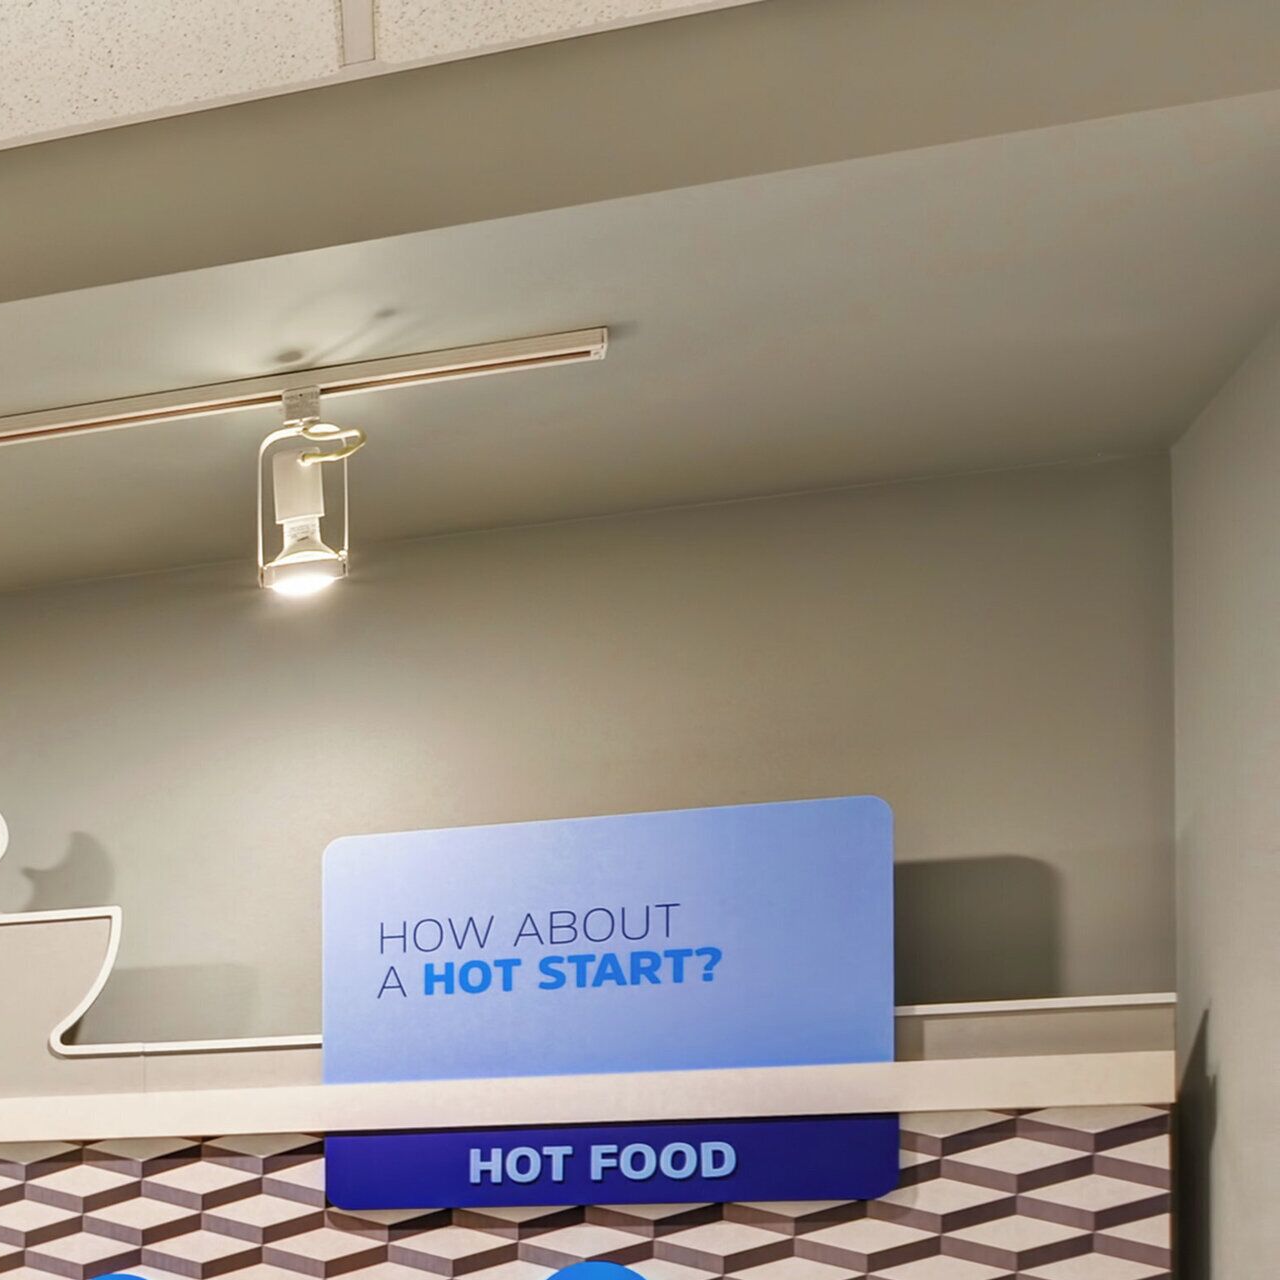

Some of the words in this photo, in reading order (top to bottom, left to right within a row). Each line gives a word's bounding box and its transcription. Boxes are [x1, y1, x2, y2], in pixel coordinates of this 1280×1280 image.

[379, 914, 494, 955] HOW
[513, 903, 681, 947] ABOUT
[377, 966, 407, 999] A
[423, 957, 521, 996] HOT
[537, 946, 723, 991] START?
[469, 1144, 573, 1184] HOT
[590, 1141, 737, 1182] FOOD
